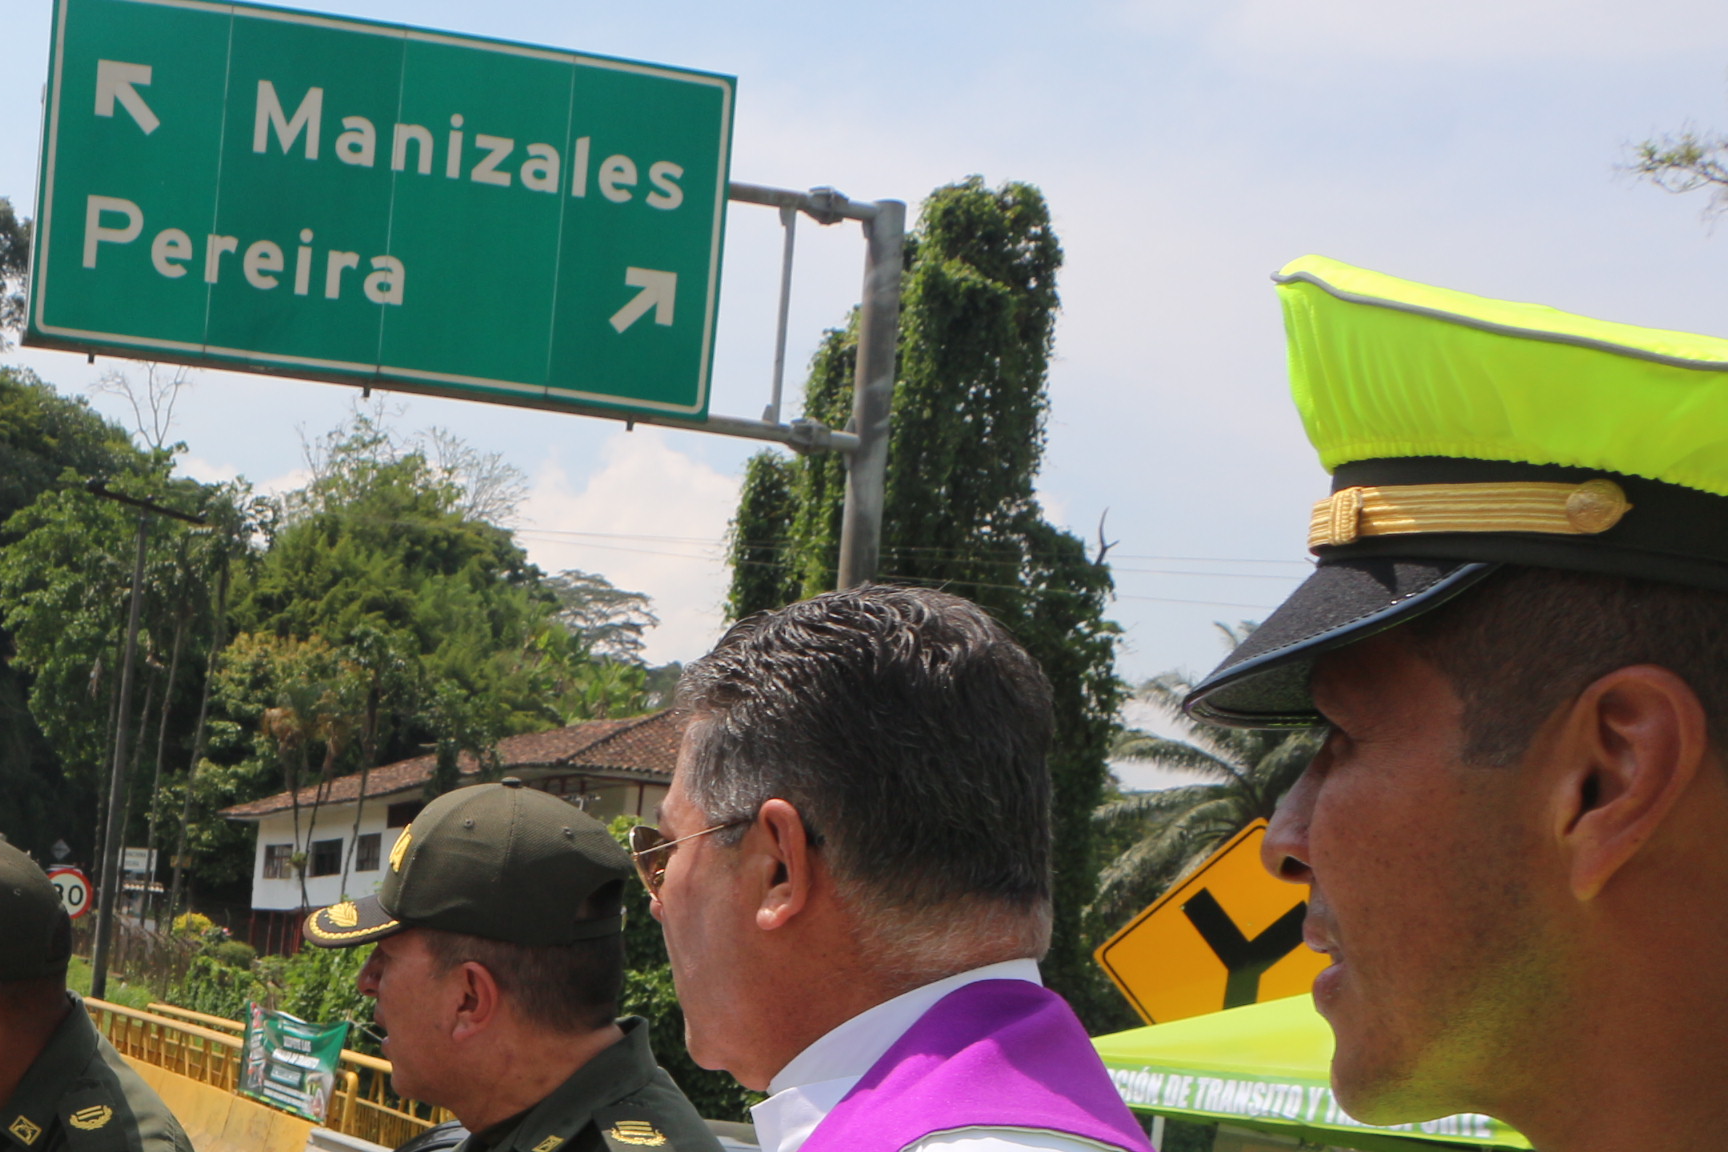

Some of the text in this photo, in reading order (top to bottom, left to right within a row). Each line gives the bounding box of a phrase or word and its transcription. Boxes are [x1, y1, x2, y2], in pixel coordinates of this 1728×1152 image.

[253, 79, 685, 212] Manizales
[83, 194, 405, 306] Pereira
[1163, 1074, 1194, 1109] DE
[1194, 1076, 1304, 1121] TRANSITO
[1305, 1086, 1326, 1122] Y
